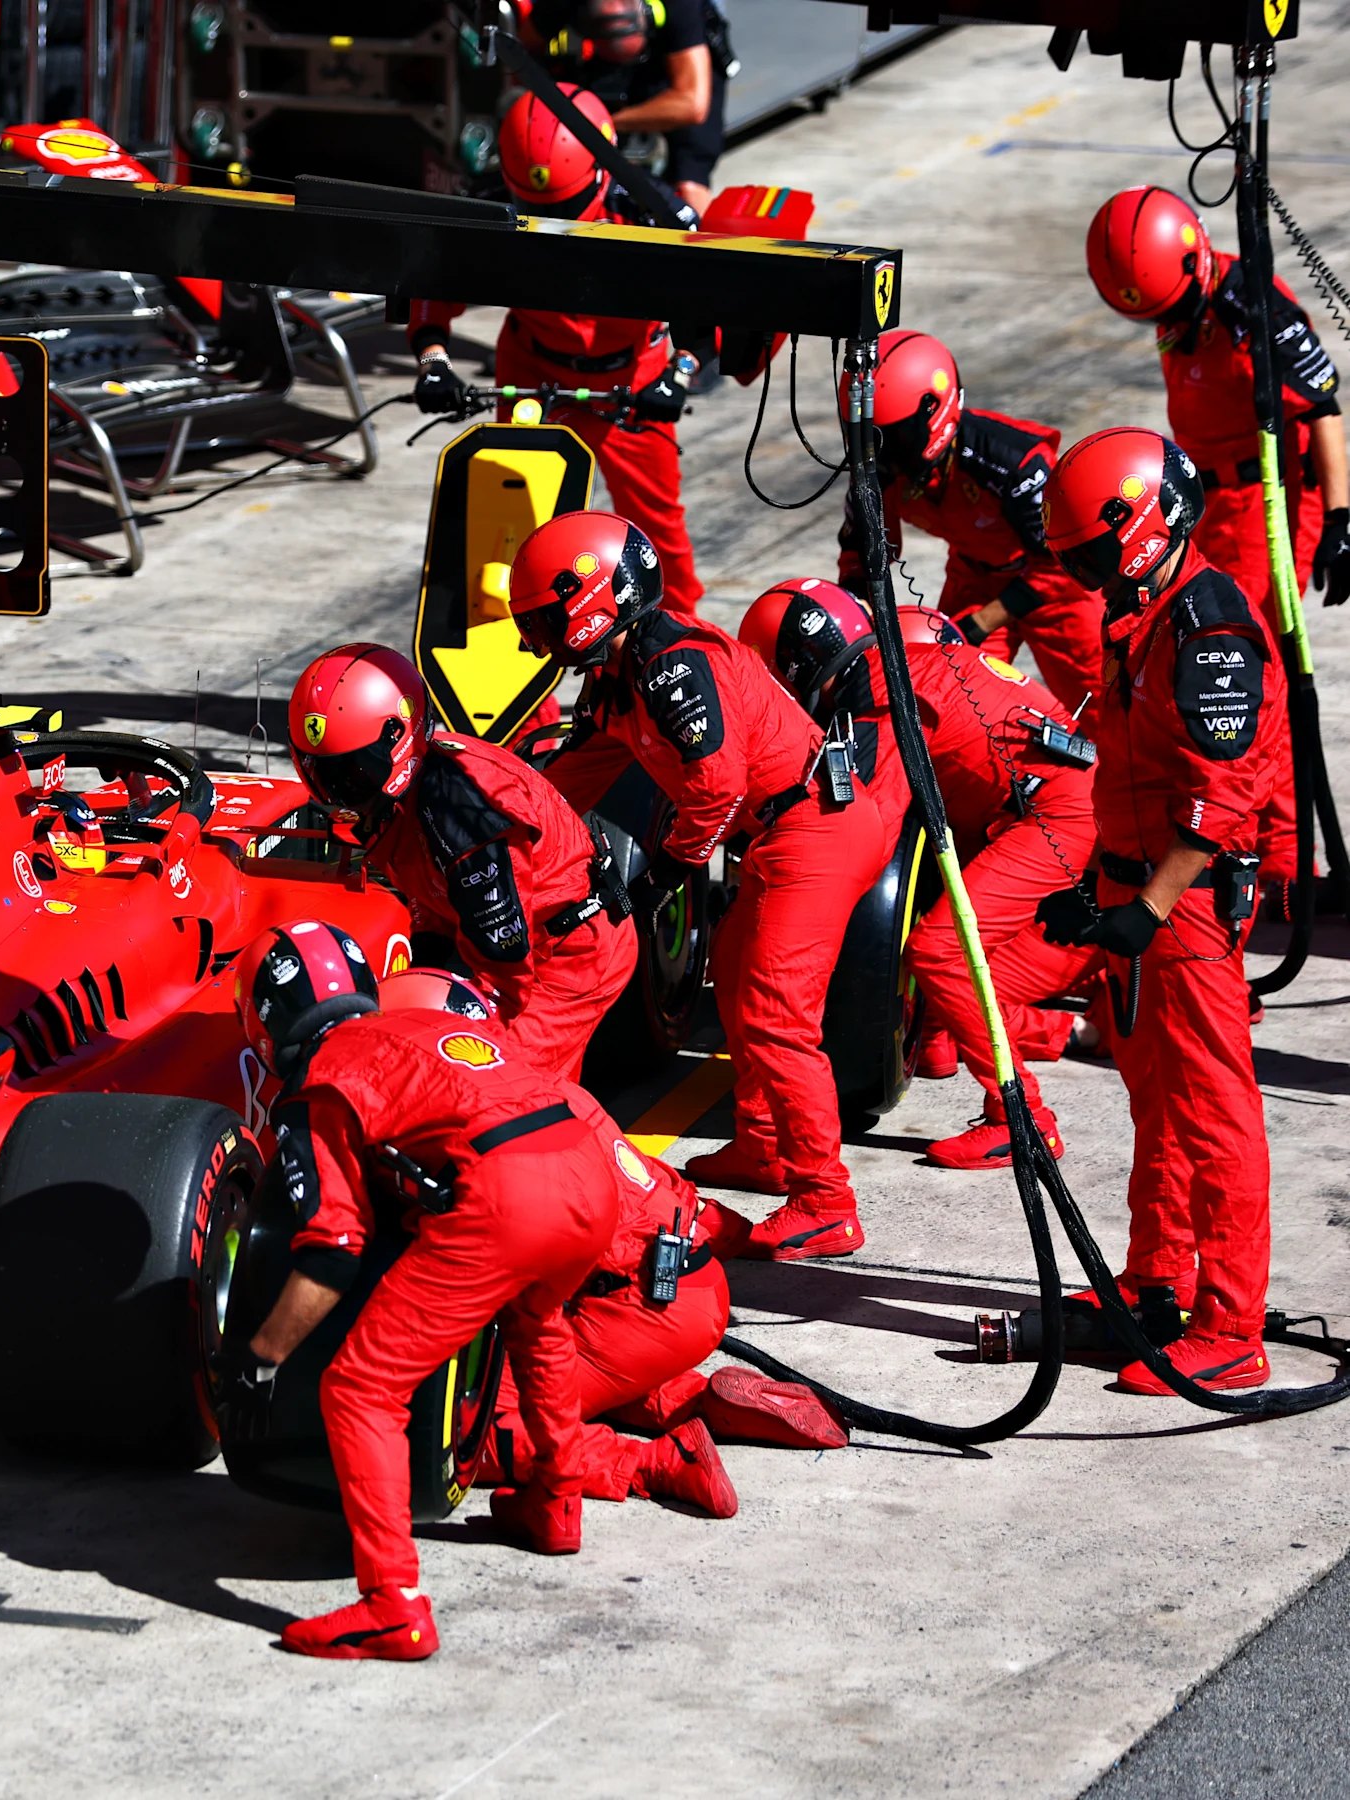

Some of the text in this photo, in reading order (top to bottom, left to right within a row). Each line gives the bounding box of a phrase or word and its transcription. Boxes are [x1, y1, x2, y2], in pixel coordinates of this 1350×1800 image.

[1120, 495, 1159, 544] RICHARD MILLE
[1123, 538, 1162, 577] CEVA
[569, 575, 611, 617] RICHARD MILLE
[568, 613, 607, 648] CEVA
[1196, 651, 1244, 664] CEVA
[648, 662, 690, 691] CEVA
[1200, 705, 1217, 713] BANG
[678, 717, 708, 744] VGW
[1204, 716, 1246, 732] VGW
[1214, 731, 1237, 741] PLAY
[393, 735, 414, 763] RICHARD
[44, 759, 65, 791] ZCG
[1191, 798, 1205, 830] HARD
[168, 858, 188, 888] aws
[461, 862, 498, 888] CEVA
[578, 903, 600, 920] PUMA
[486, 916, 523, 943] VGW
[500, 932, 523, 949] PLAY
[191, 1141, 225, 1268] ZERO
